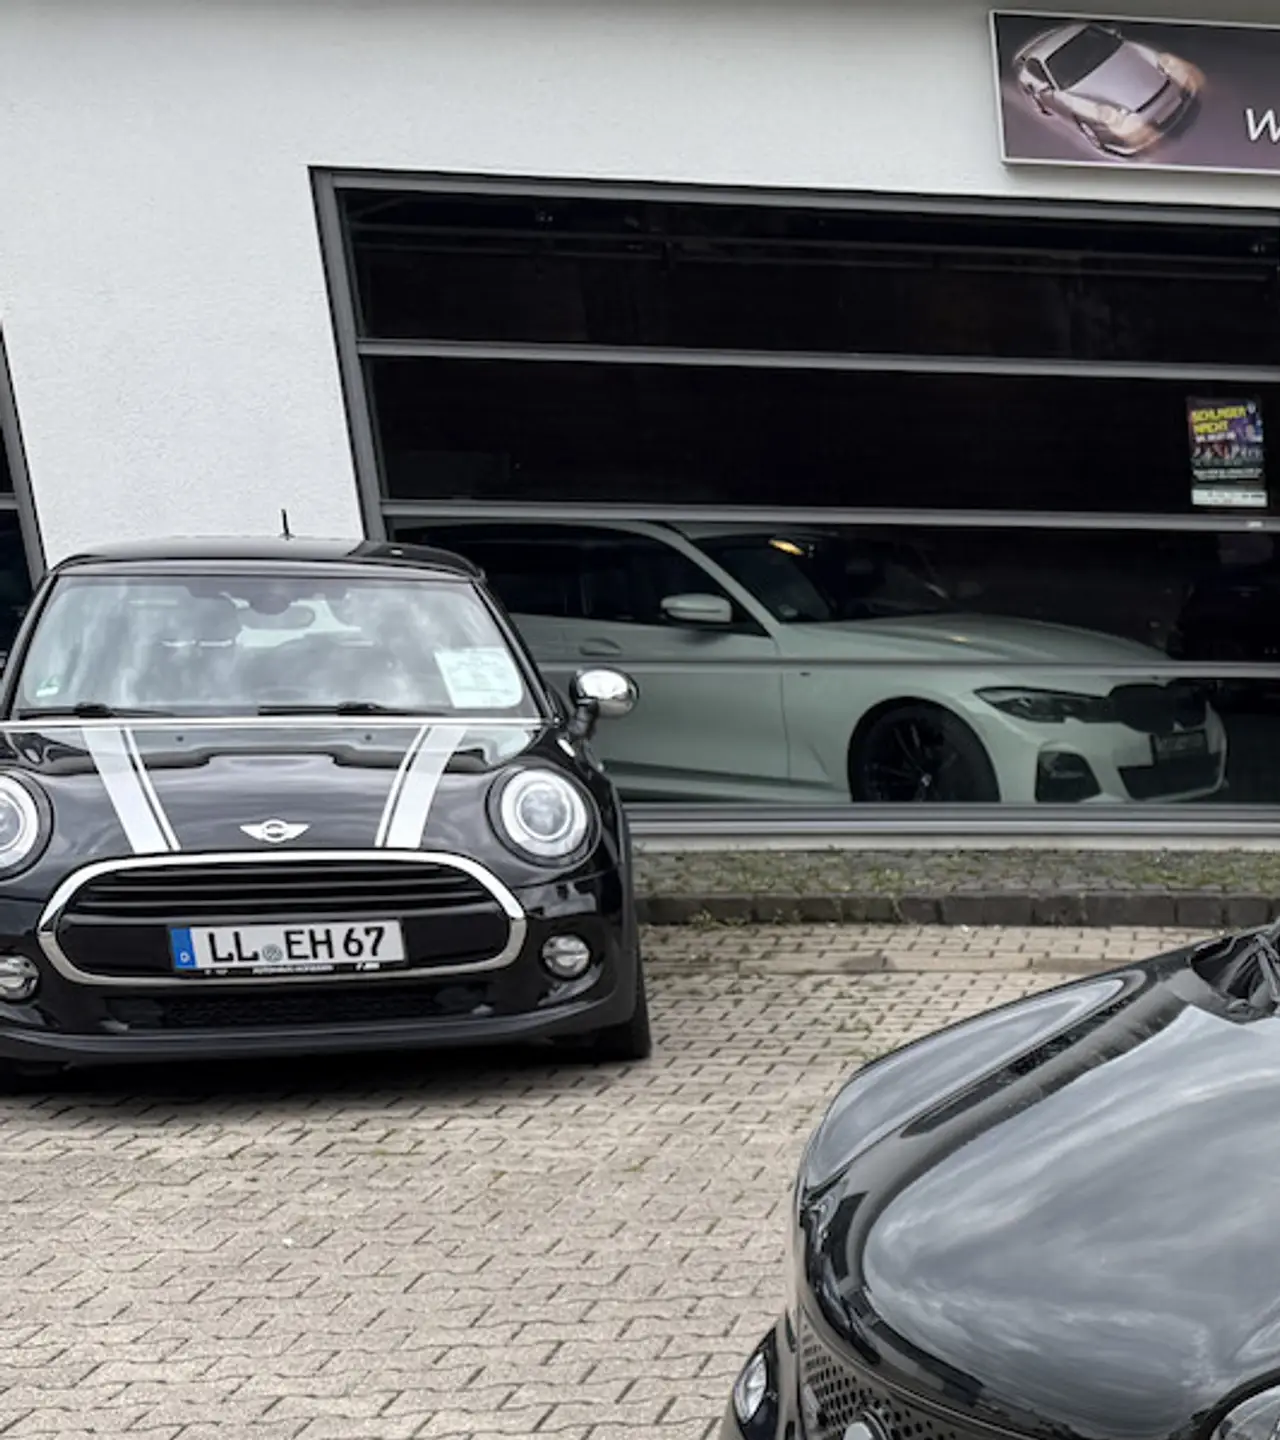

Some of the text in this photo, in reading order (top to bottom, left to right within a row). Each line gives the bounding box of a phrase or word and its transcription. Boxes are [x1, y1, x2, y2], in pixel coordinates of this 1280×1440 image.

[208, 926, 385, 962] LL EH 67
